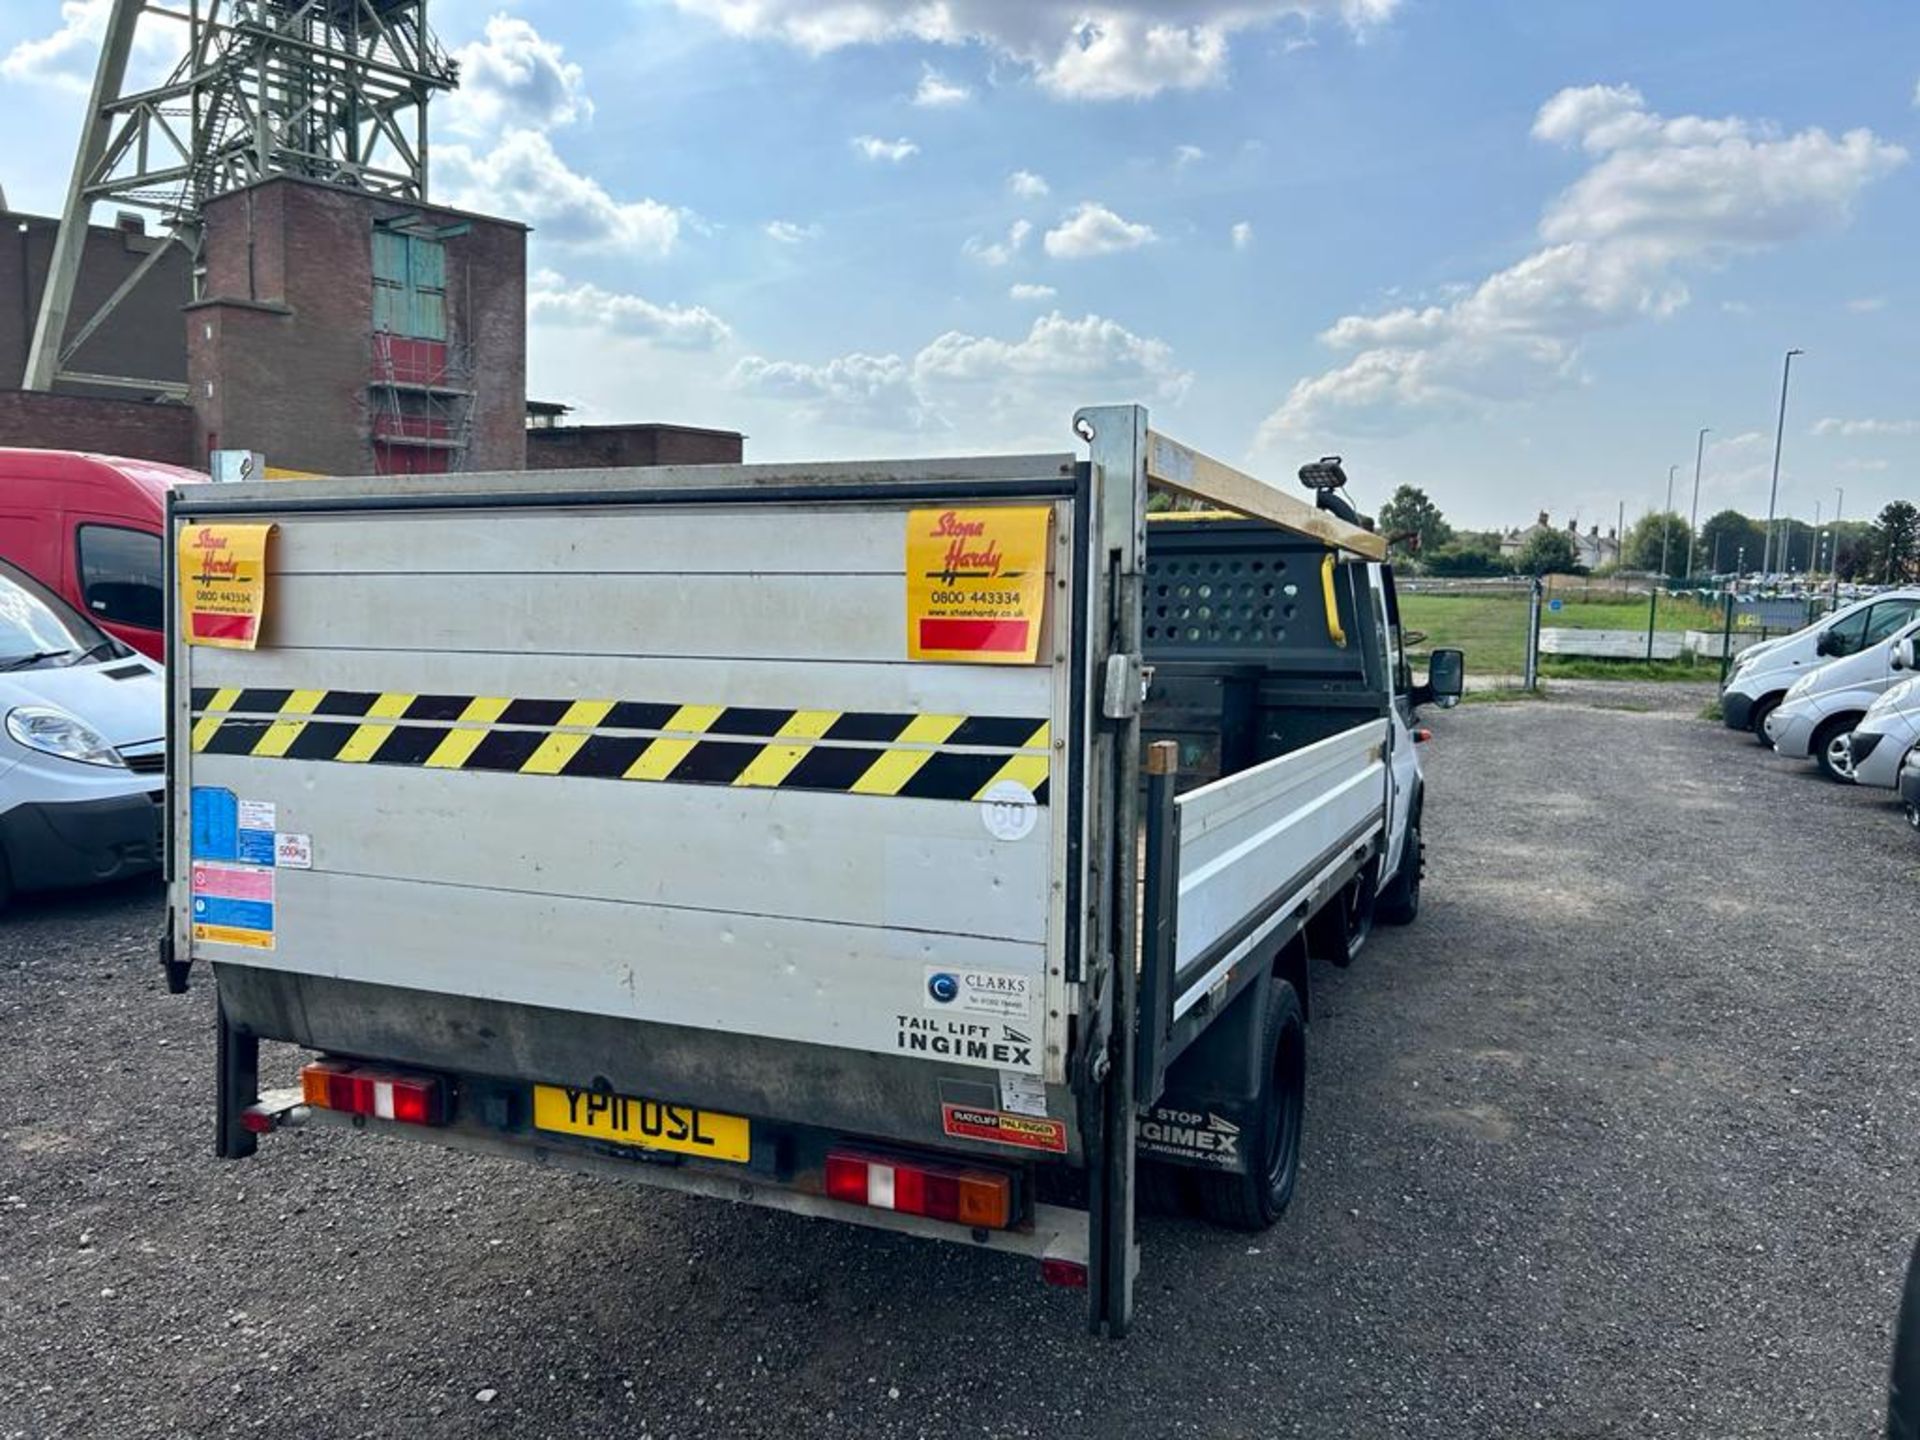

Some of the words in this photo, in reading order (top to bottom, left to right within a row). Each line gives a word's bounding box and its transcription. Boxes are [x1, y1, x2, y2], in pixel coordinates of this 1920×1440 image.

[929, 511, 985, 538] Stone
[944, 538, 1002, 578] Hardy
[196, 590, 218, 602] 0800
[931, 590, 965, 605] 0800
[970, 591, 1021, 606] 443334
[964, 974, 1026, 993] CLARKS
[897, 1015, 940, 1032] TAIL
[948, 1022, 990, 1038] LIFT
[897, 1031, 1032, 1066] INGIMEX
[1157, 1107, 1203, 1124] STOP
[1135, 1120, 1238, 1155] GIMEX
